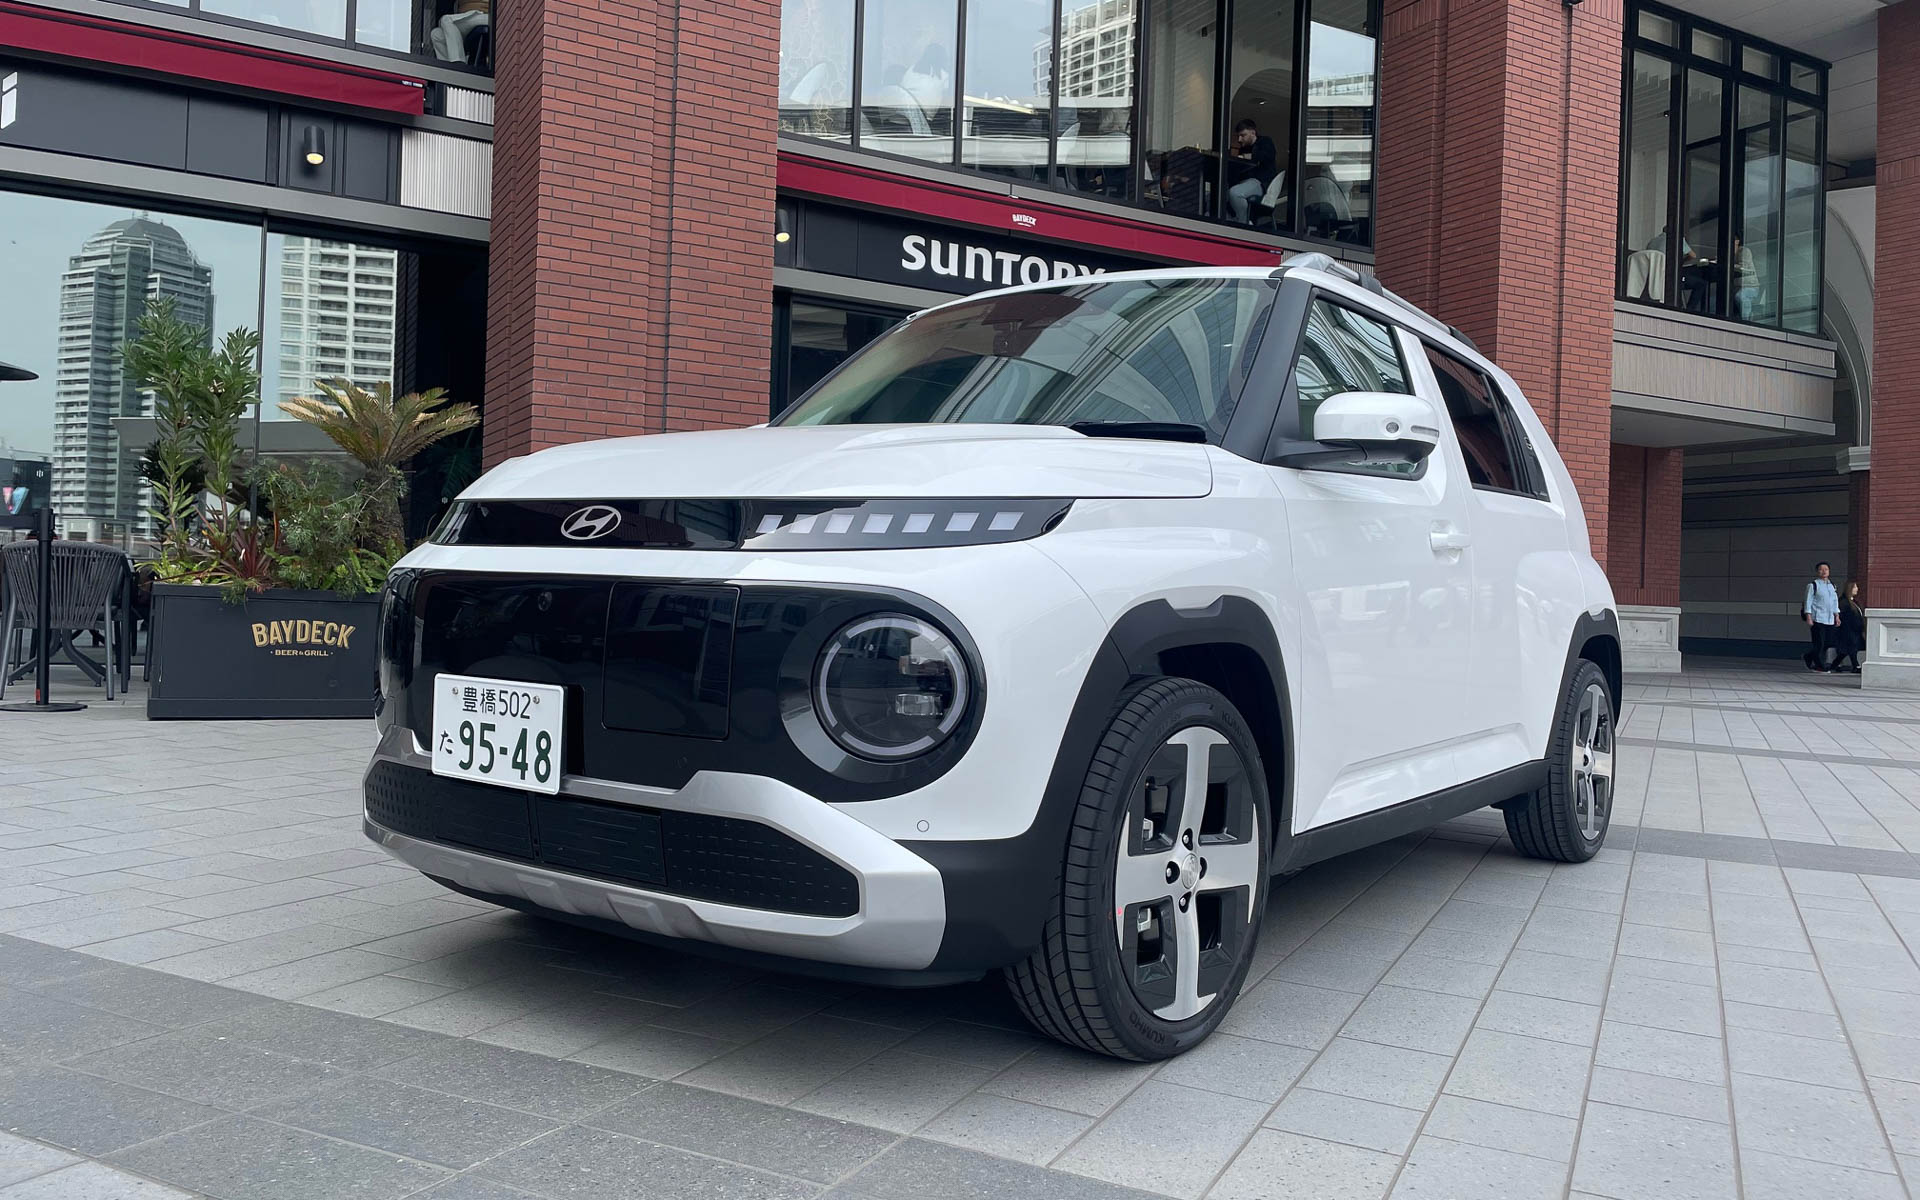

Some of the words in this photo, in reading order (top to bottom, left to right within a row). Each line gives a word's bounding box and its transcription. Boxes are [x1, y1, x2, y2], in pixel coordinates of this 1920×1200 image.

[251, 619, 356, 650] BAYDECK
[439, 729, 454, 755] た
[458, 720, 552, 783] 95-48
